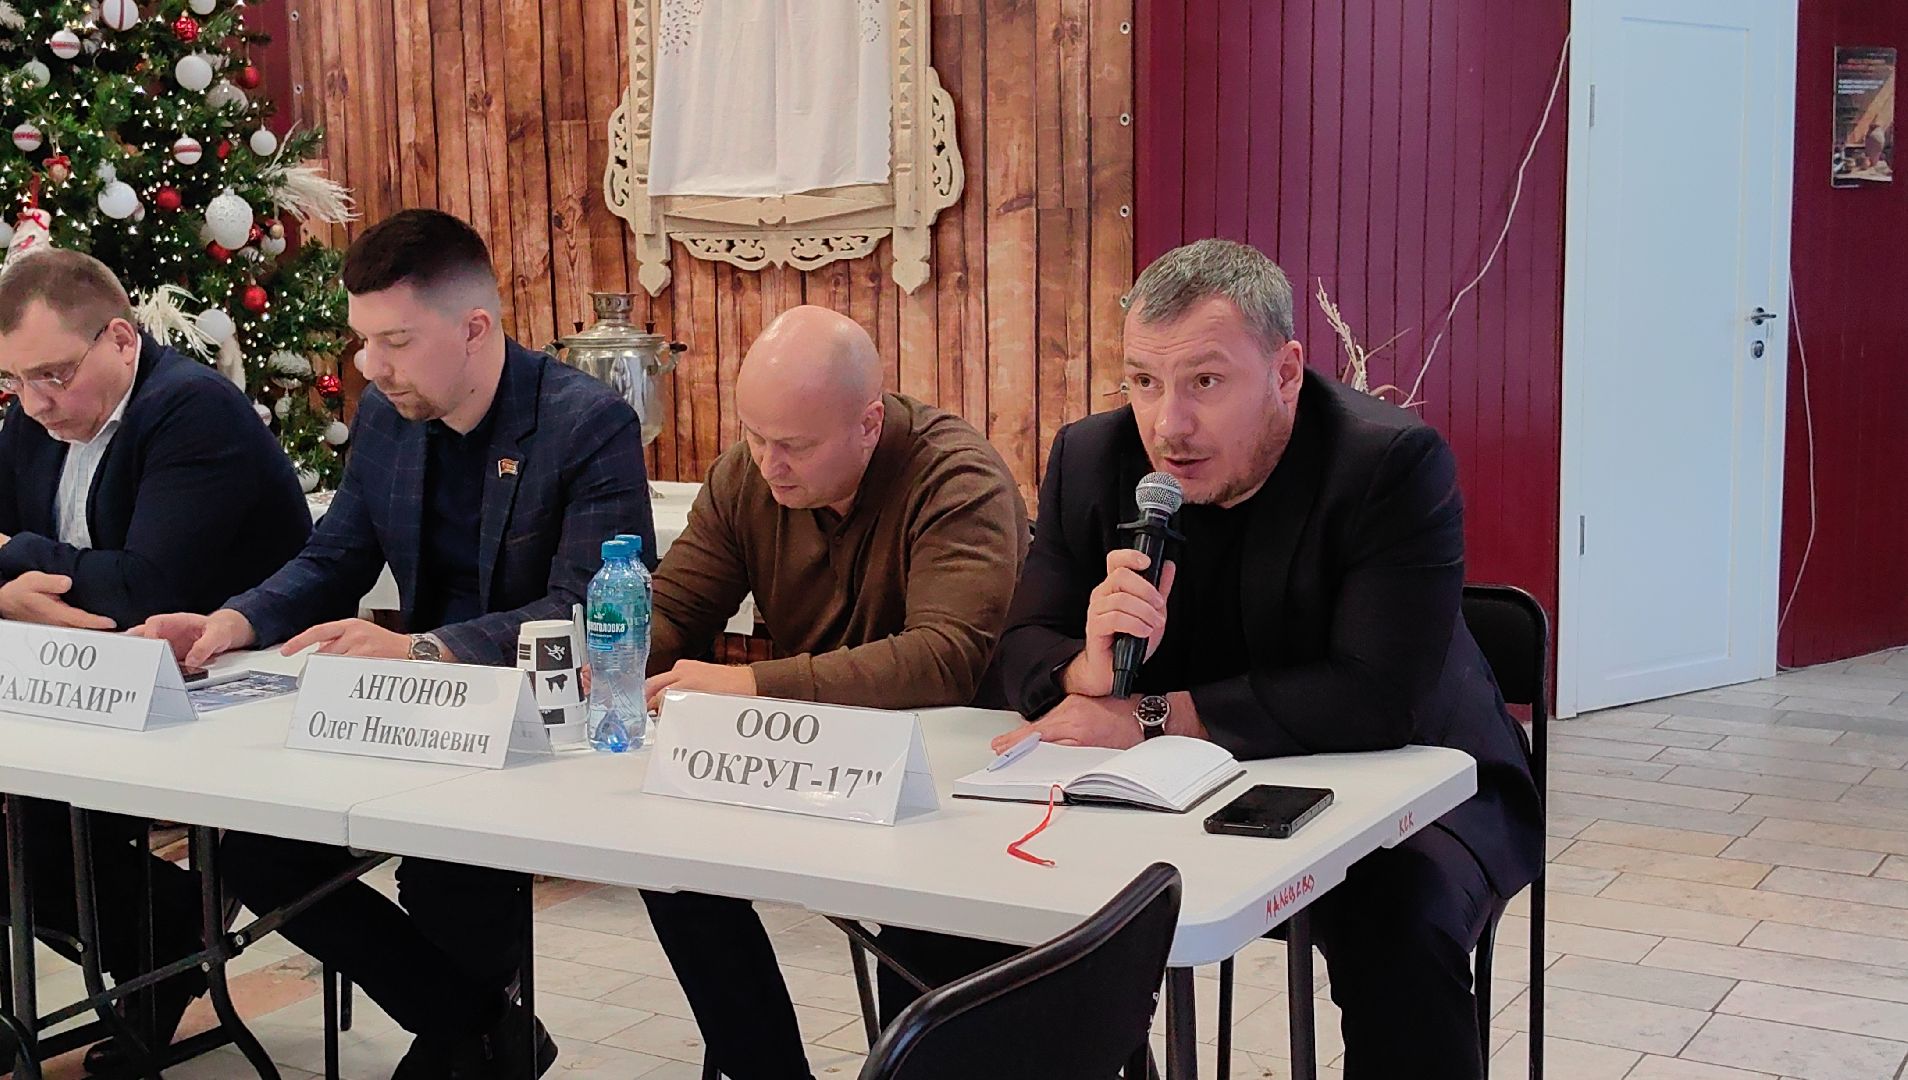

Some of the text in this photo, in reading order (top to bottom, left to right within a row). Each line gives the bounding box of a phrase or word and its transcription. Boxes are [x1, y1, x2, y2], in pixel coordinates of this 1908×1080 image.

[39, 640, 97, 671] ООО
[348, 673, 469, 708] АНТОНОВ
[308, 710, 491, 754] Олег Николаевич
[736, 708, 821, 745] ООО
[672, 747, 883, 798] "ОКРУГ-17"
